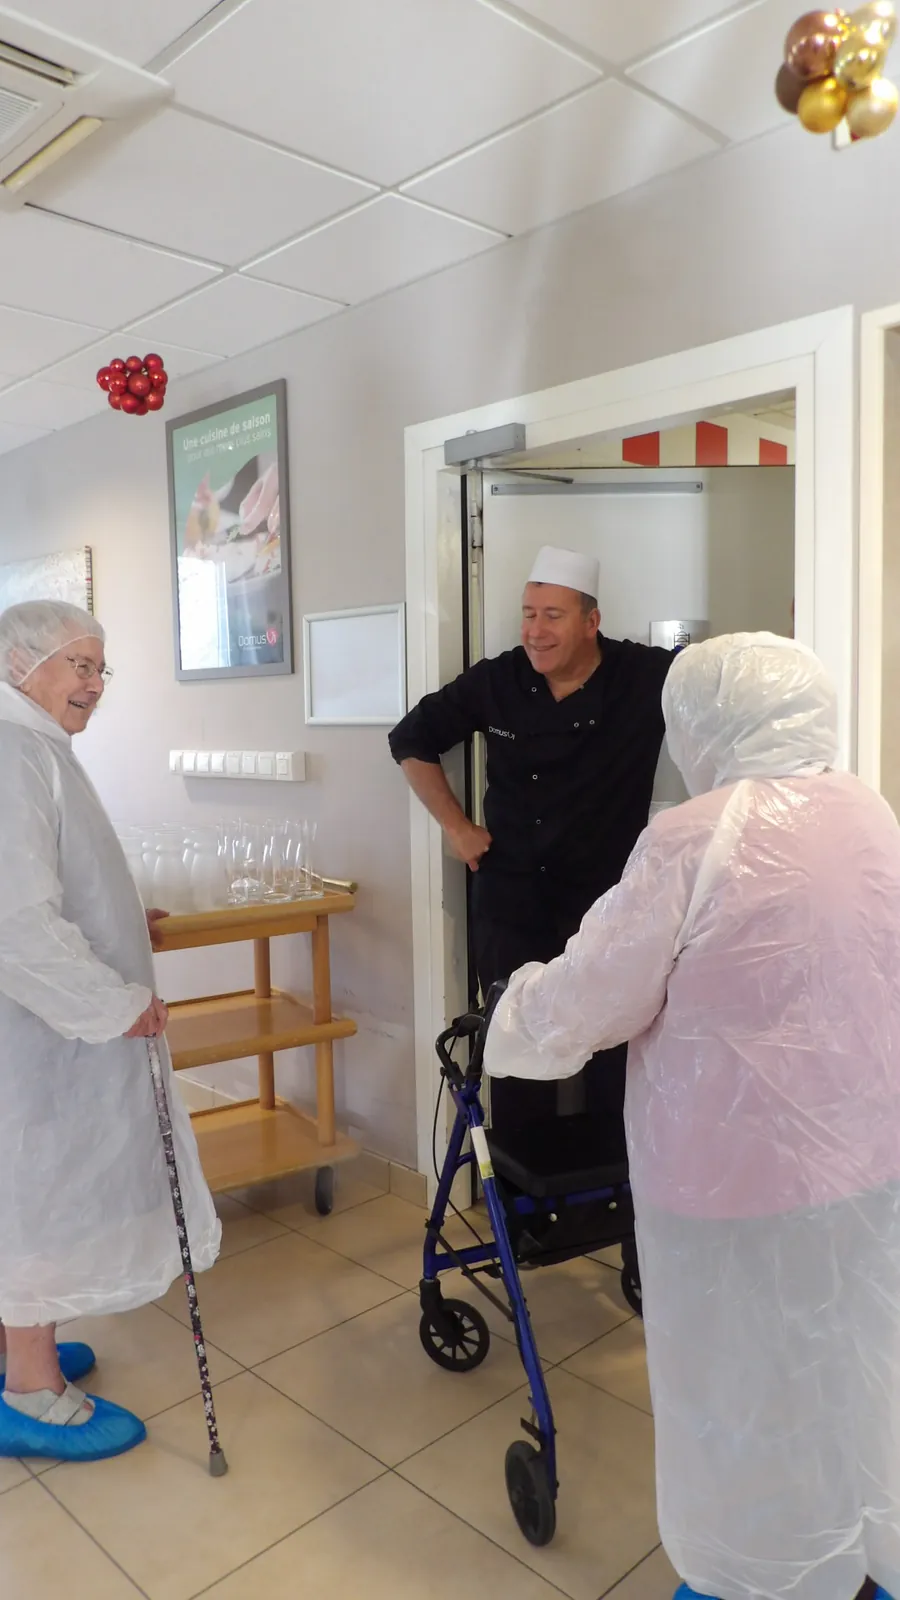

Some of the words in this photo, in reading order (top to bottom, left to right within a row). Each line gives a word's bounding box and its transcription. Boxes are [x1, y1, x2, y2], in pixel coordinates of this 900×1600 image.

[183, 437, 199, 451] Une
[200, 427, 228, 445] cuisine
[230, 421, 240, 436] de
[242, 413, 271, 431] saison
